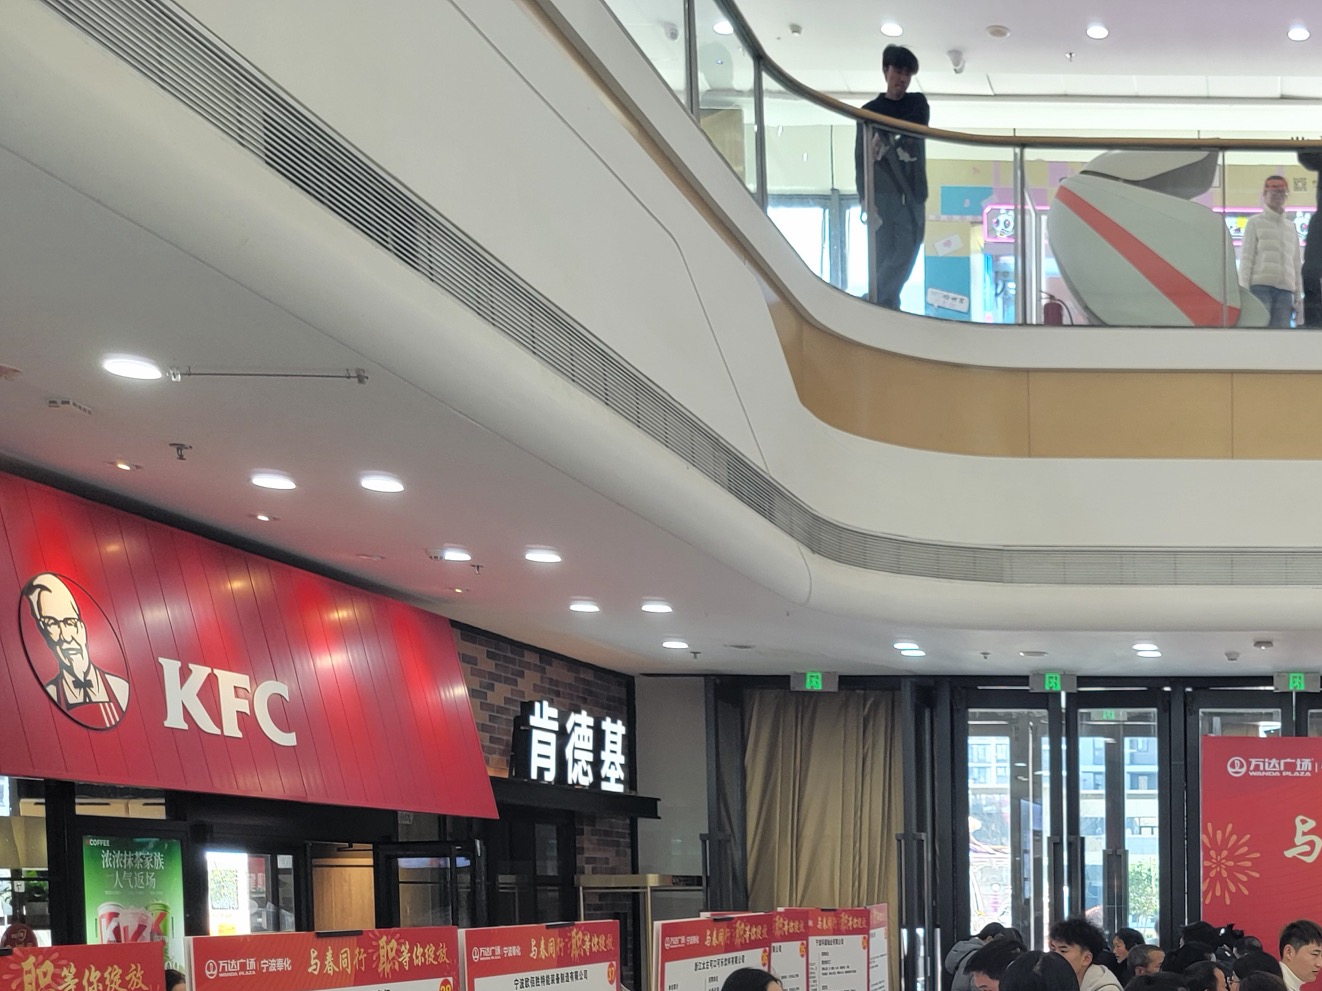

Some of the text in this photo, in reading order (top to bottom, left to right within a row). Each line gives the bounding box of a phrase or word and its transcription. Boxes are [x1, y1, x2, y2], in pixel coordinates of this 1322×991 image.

[158, 657, 298, 747] KFC
[529, 701, 626, 793] 肯德基
[1249, 758, 1313, 771] 万达广场
[101, 849, 164, 870] 浓浓抹茶家族
[218, 958, 256, 972] 万达广场
[261, 957, 292, 972] 宁波奉化
